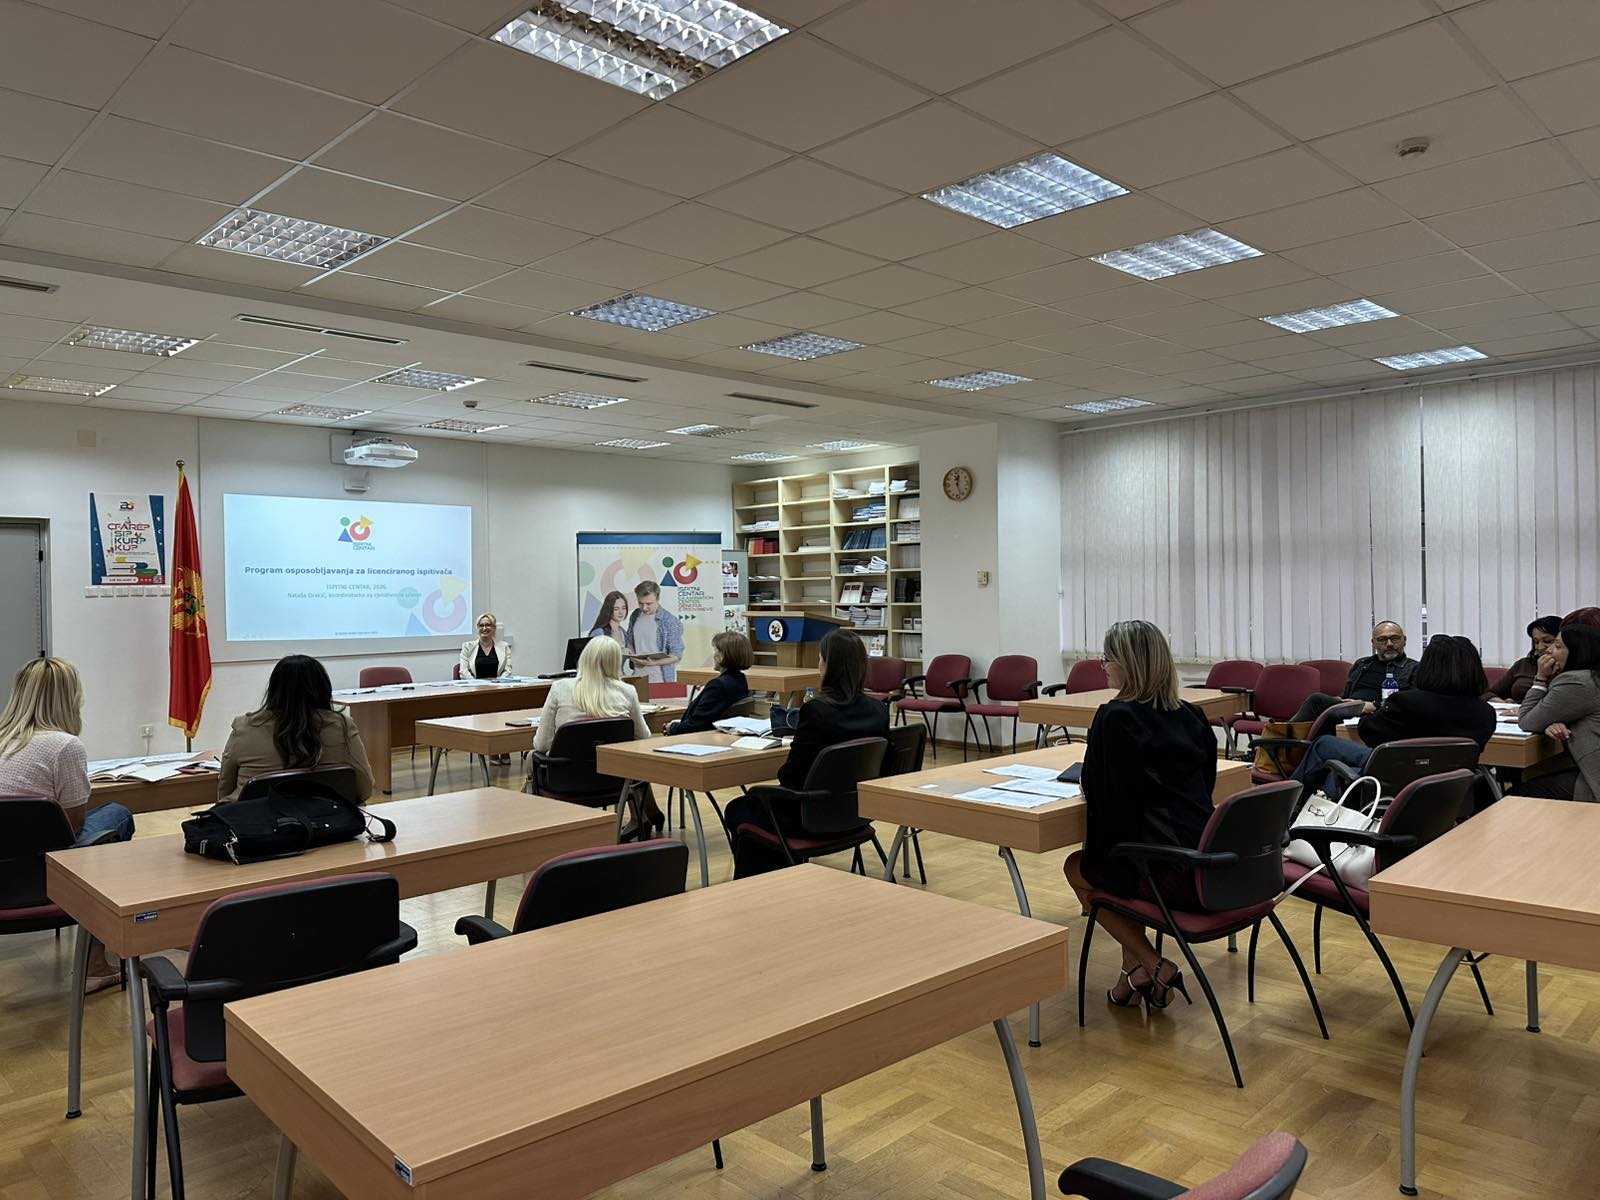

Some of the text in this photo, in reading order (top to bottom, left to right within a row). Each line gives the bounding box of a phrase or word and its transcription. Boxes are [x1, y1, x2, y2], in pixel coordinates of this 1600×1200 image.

[244, 566, 283, 575] Program
[285, 567, 354, 576] osposobljavanja
[367, 567, 415, 576] licenciranog
[416, 568, 453, 576] ispitivača
